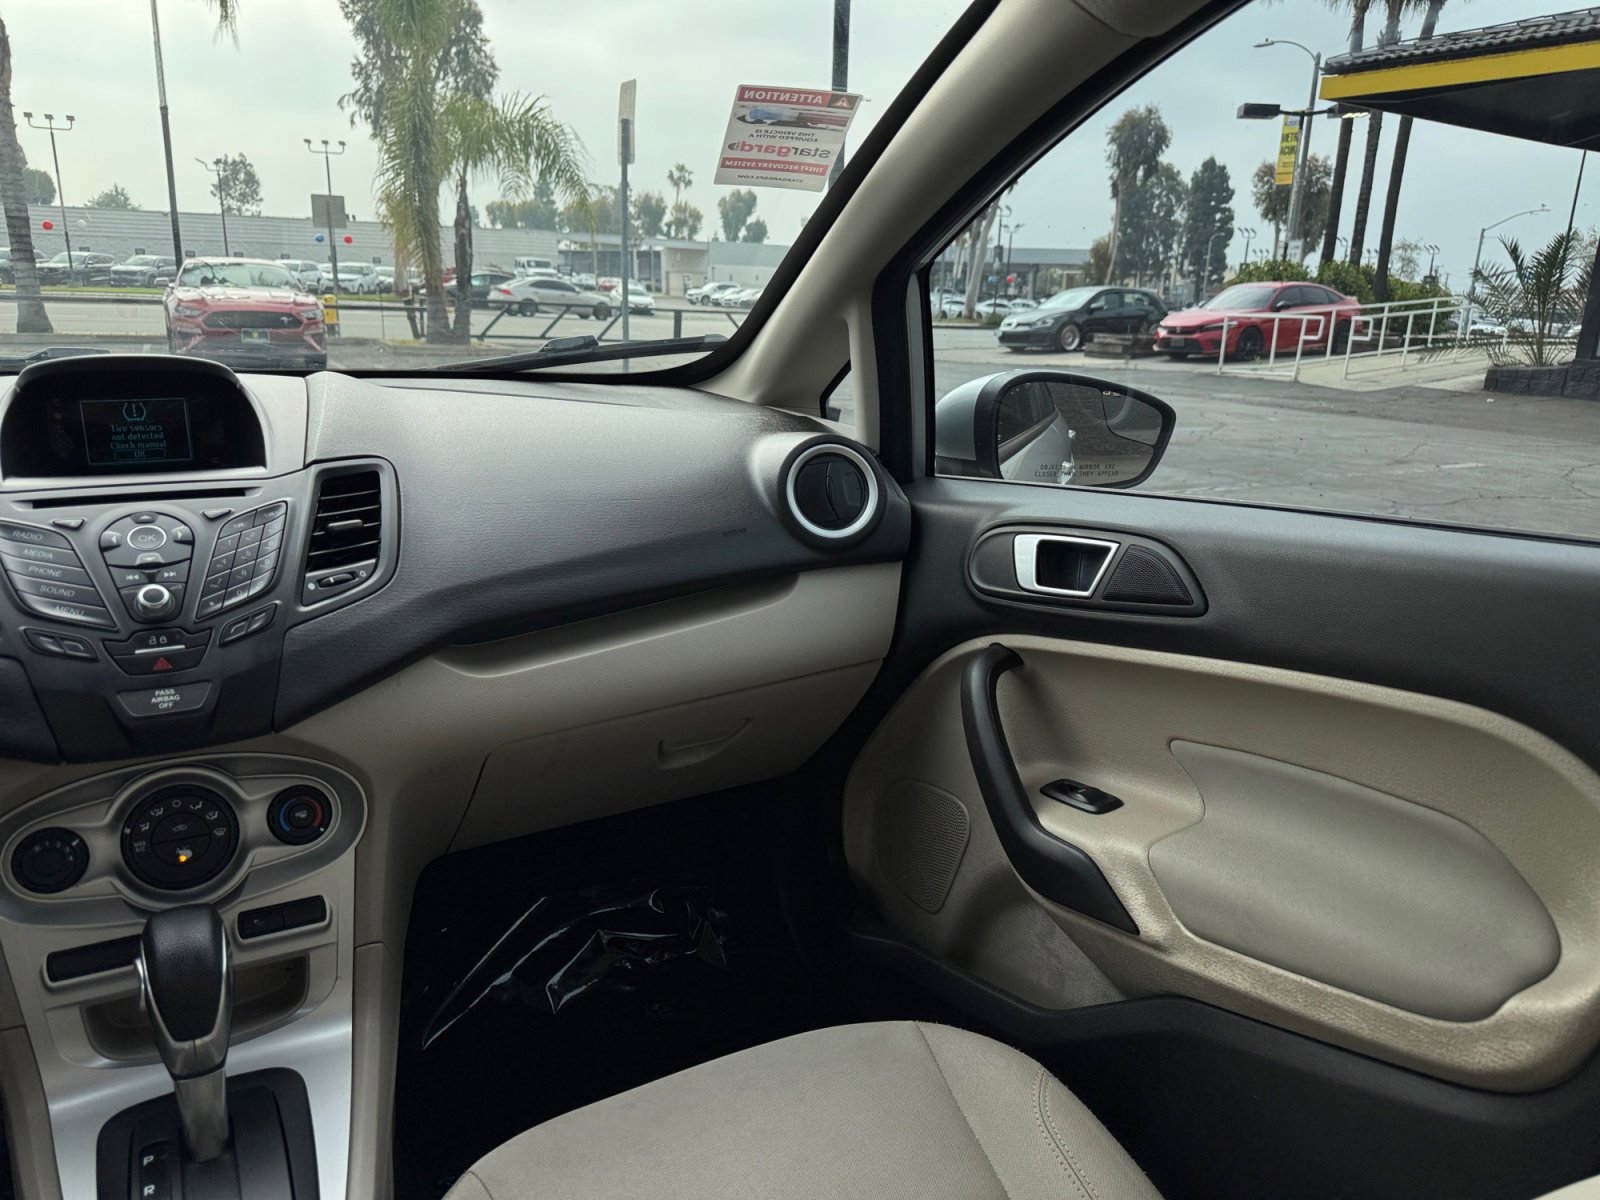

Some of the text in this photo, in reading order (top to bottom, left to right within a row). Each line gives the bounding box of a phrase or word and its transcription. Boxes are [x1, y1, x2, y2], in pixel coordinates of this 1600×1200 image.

[12, 529, 43, 541] RADIO
[138, 533, 157, 542] OK
[23, 548, 53, 560] MEDIA
[27, 565, 63, 577] PHONE
[39, 585, 75, 597] SOUND
[54, 604, 85, 617] MENU
[154, 688, 176, 696] PASS
[150, 694, 181, 704] AIRBAG
[158, 702, 174, 710] OFF
[143, 1155, 154, 1166] P
[143, 1184, 155, 1196] R
